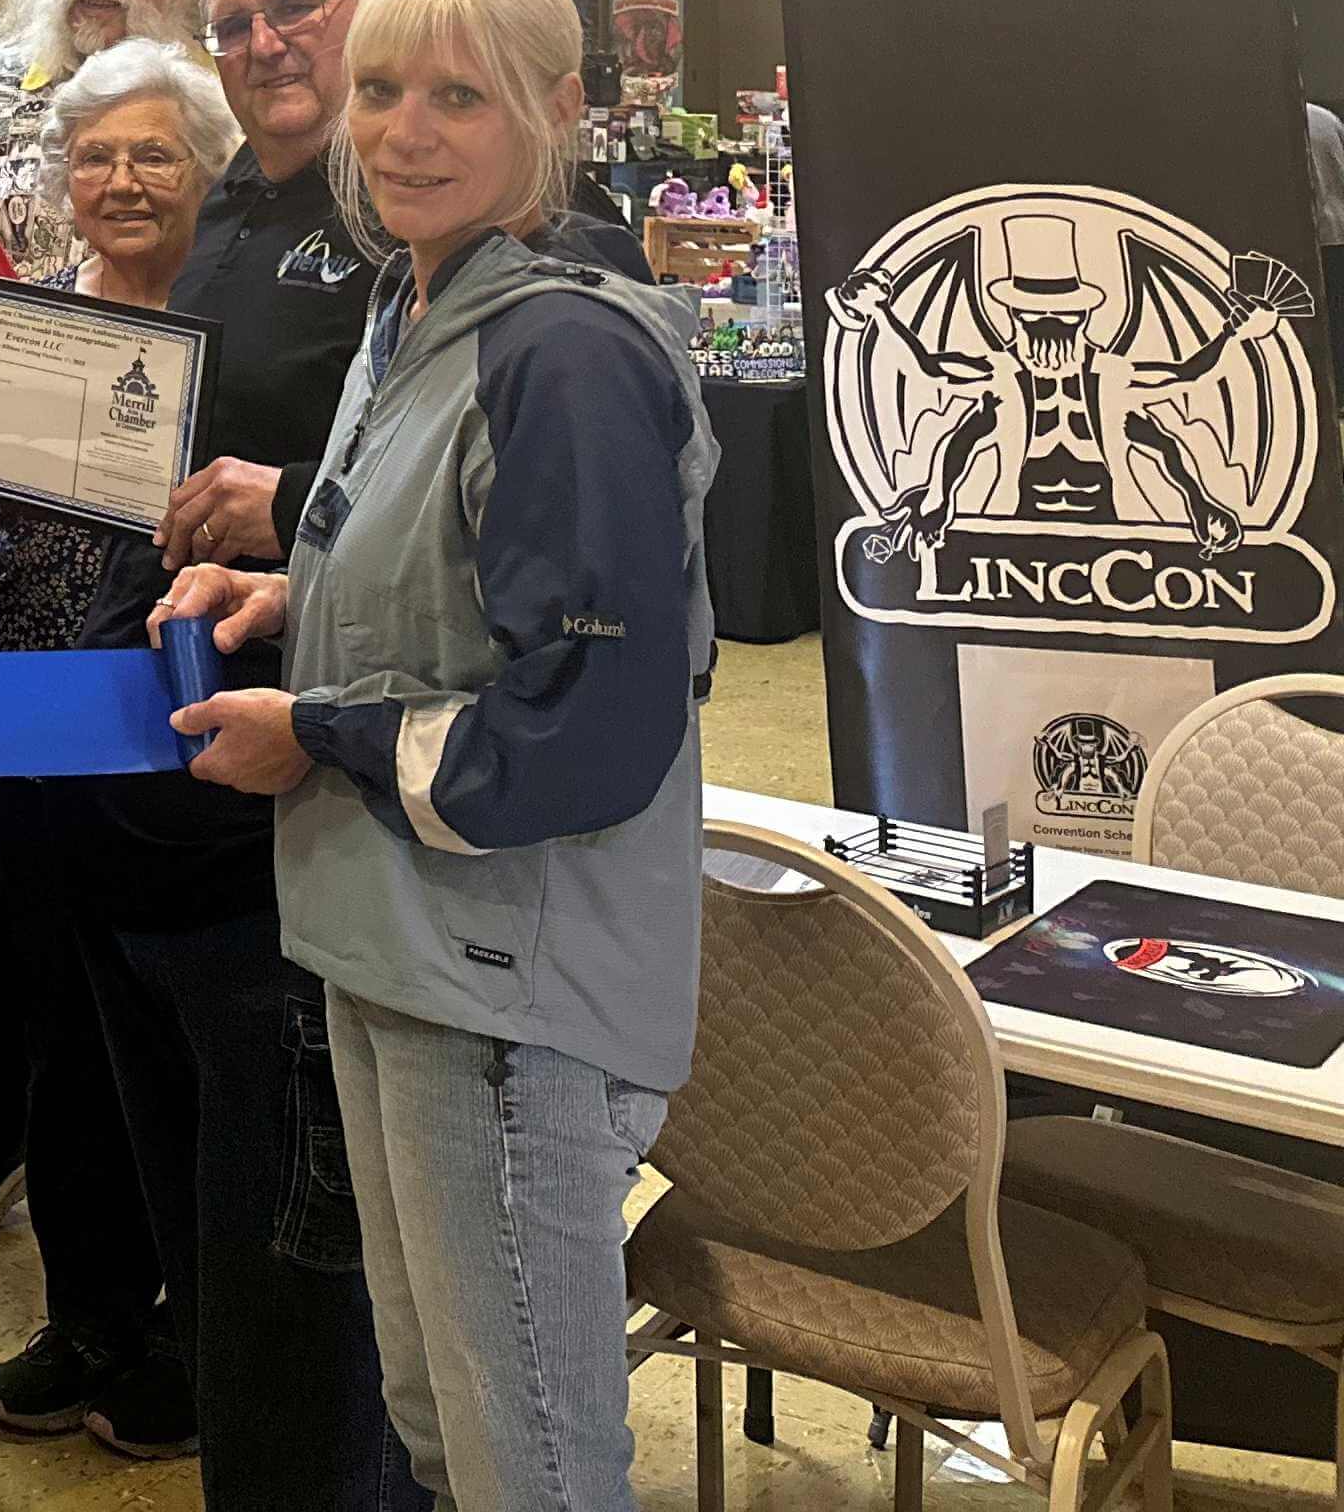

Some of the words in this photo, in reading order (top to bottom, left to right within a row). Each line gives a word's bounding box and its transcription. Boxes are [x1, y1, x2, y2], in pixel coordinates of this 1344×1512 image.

[5, 331, 41, 347] Evercon
[112, 392, 155, 412] Merrill
[109, 407, 157, 428] Chamber
[1033, 824, 1101, 839] Convention
[1103, 829, 1133, 842] Sche
